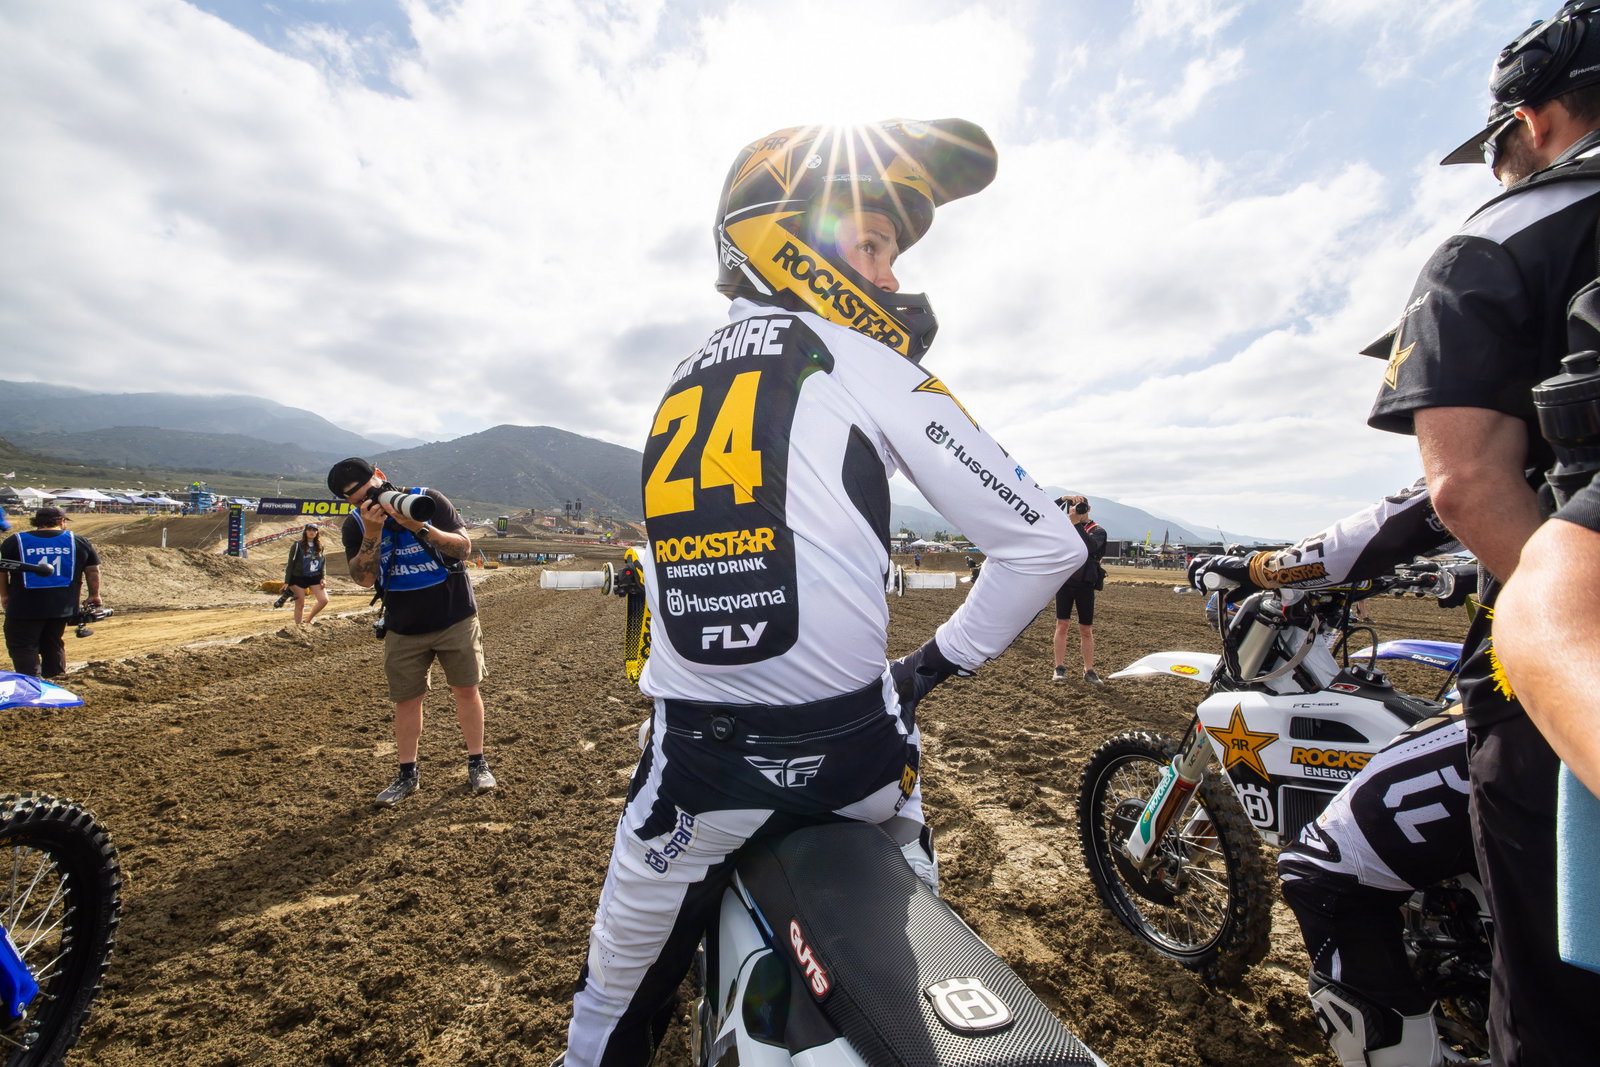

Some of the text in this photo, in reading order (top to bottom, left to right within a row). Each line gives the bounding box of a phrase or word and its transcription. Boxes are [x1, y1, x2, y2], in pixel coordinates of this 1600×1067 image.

[771, 241, 904, 348] ROCKSTAR
[644, 371, 763, 518] 24
[945, 437, 1041, 525] Husqvarna
[26, 547, 71, 556] PRESS
[655, 527, 776, 563] ROCKSTAR
[666, 557, 767, 578] ENERGY DRINK
[686, 589, 786, 614] Husqvarna
[702, 621, 768, 650] FLY
[1304, 766, 1356, 779] ENERGY
[790, 921, 829, 995] GUTS
